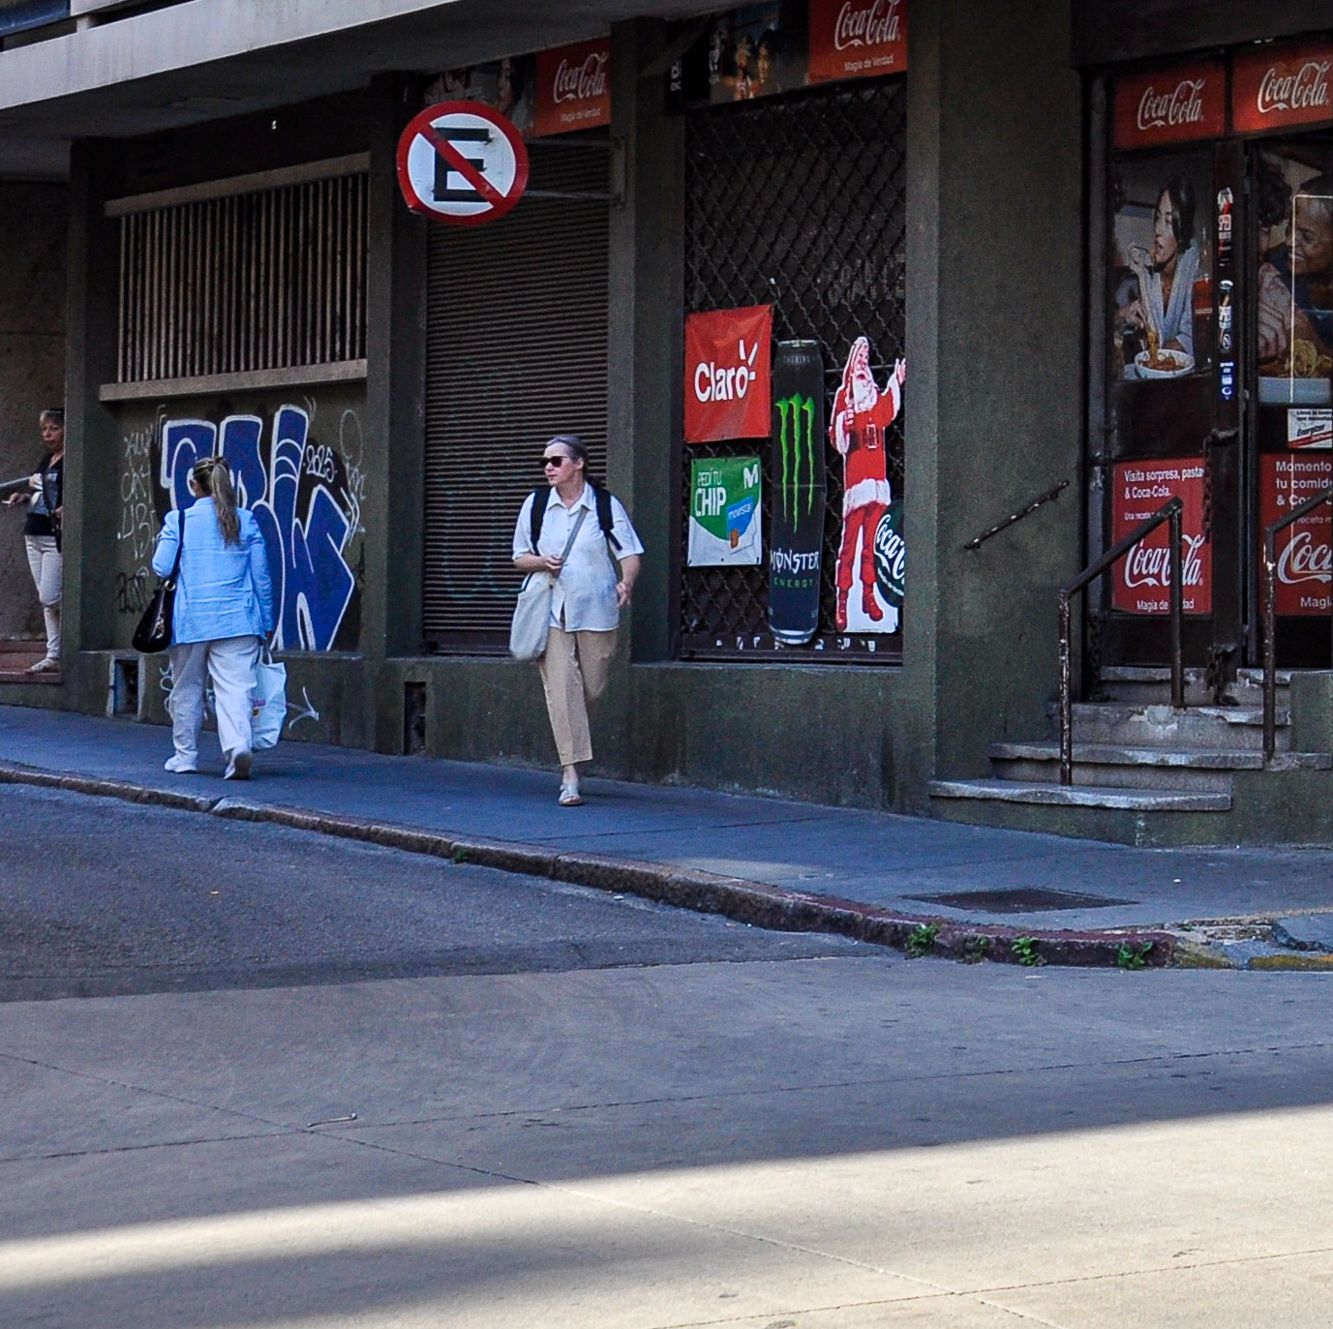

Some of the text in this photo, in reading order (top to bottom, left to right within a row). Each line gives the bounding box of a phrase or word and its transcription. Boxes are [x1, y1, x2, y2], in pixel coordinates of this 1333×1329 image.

[1137, 77, 1206, 131] Coca-Cola
[1257, 60, 1333, 114] Coca-Cola
[434, 127, 490, 203] E
[694, 362, 748, 403] Claro
[1275, 460, 1332, 472] Momento
[1276, 478, 1332, 489] tu comid
[694, 487, 727, 517] CHIP
[1300, 595, 1332, 609] Magi
